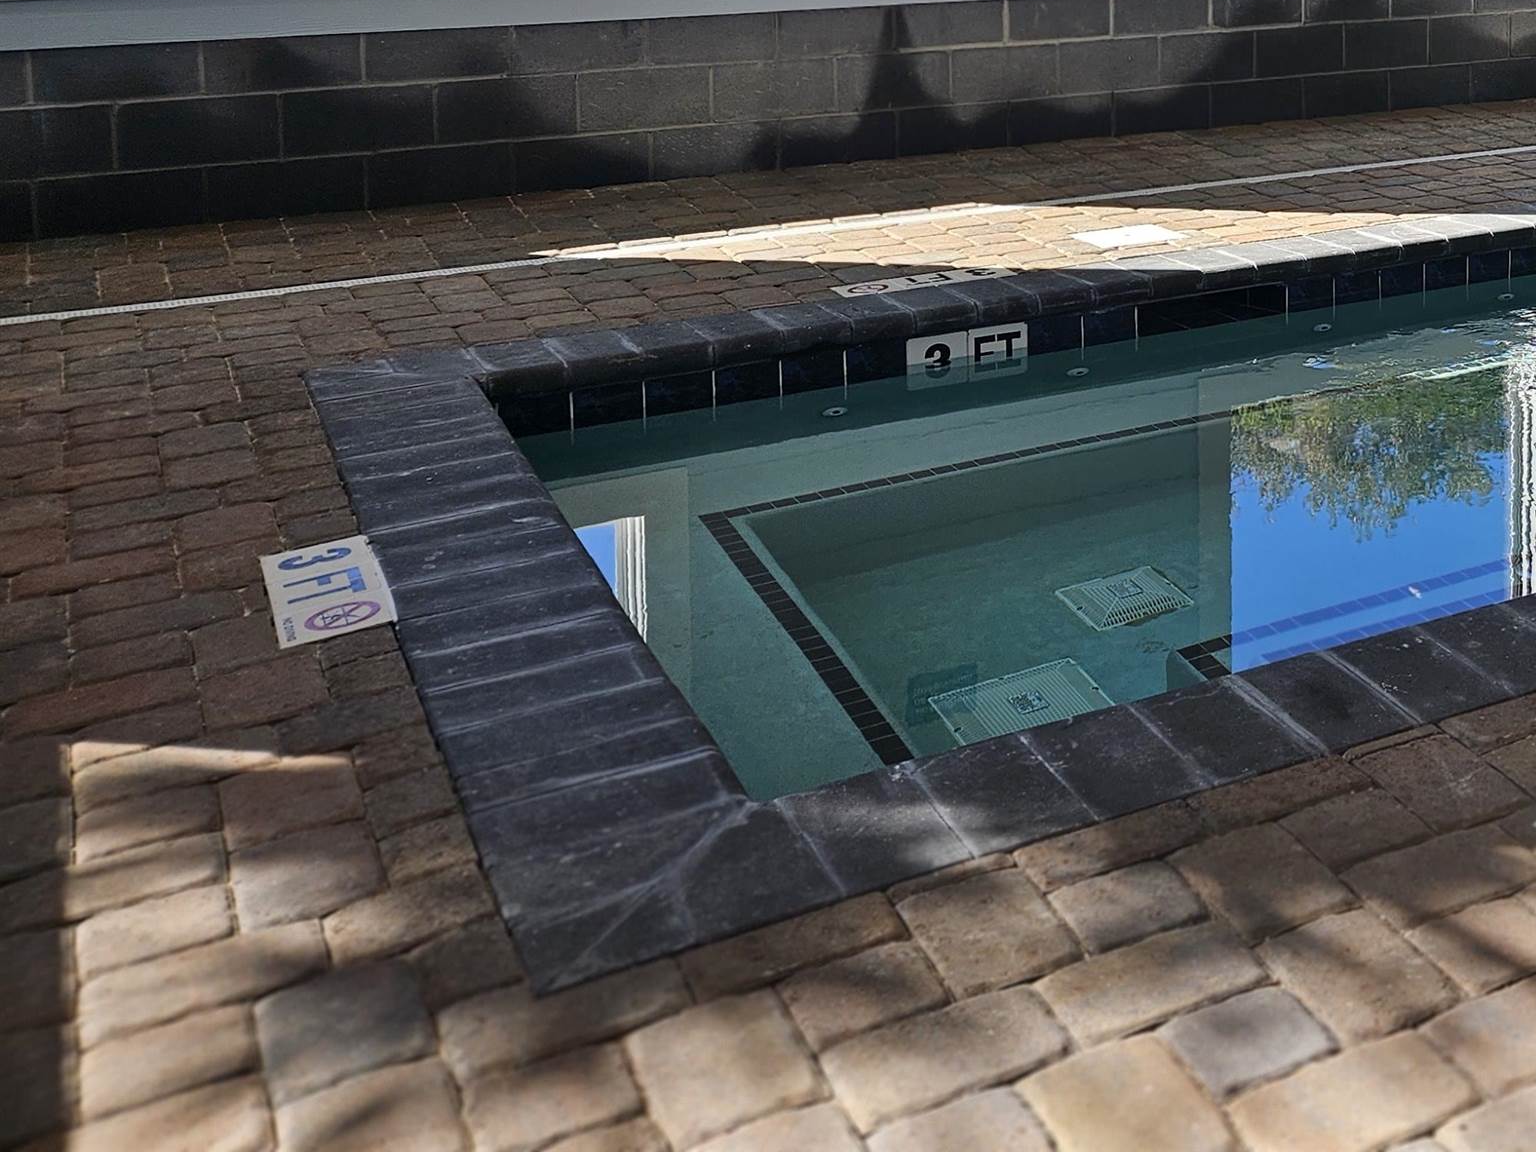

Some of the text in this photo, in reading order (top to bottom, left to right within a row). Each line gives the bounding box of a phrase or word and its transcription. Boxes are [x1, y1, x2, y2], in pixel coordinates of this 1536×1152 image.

[924, 330, 1021, 369] 3 FT
[278, 547, 367, 605] 3 FT
